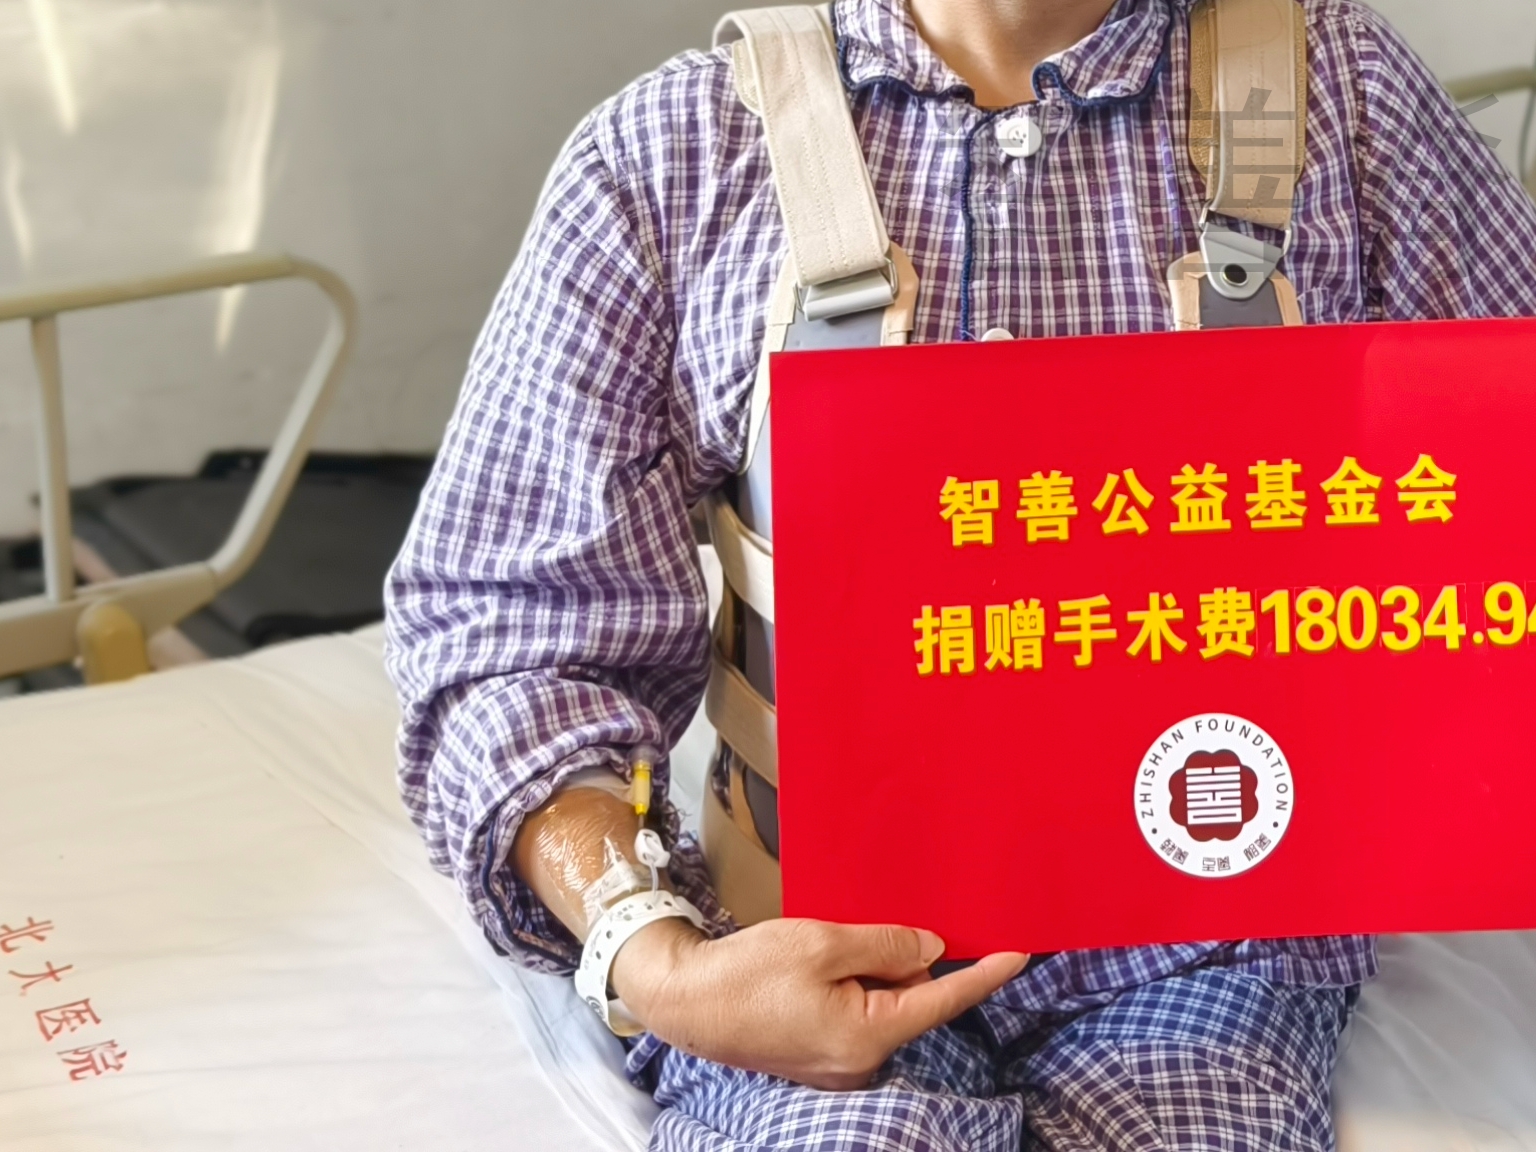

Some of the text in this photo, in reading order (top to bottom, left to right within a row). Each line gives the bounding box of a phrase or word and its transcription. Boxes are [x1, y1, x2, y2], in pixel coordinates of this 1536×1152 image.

[939, 454, 1458, 546] 智善公益基金会
[1140, 718, 1288, 818] ZHISHAN FOUNDATION
[0, 916, 127, 1081] 北大医院
